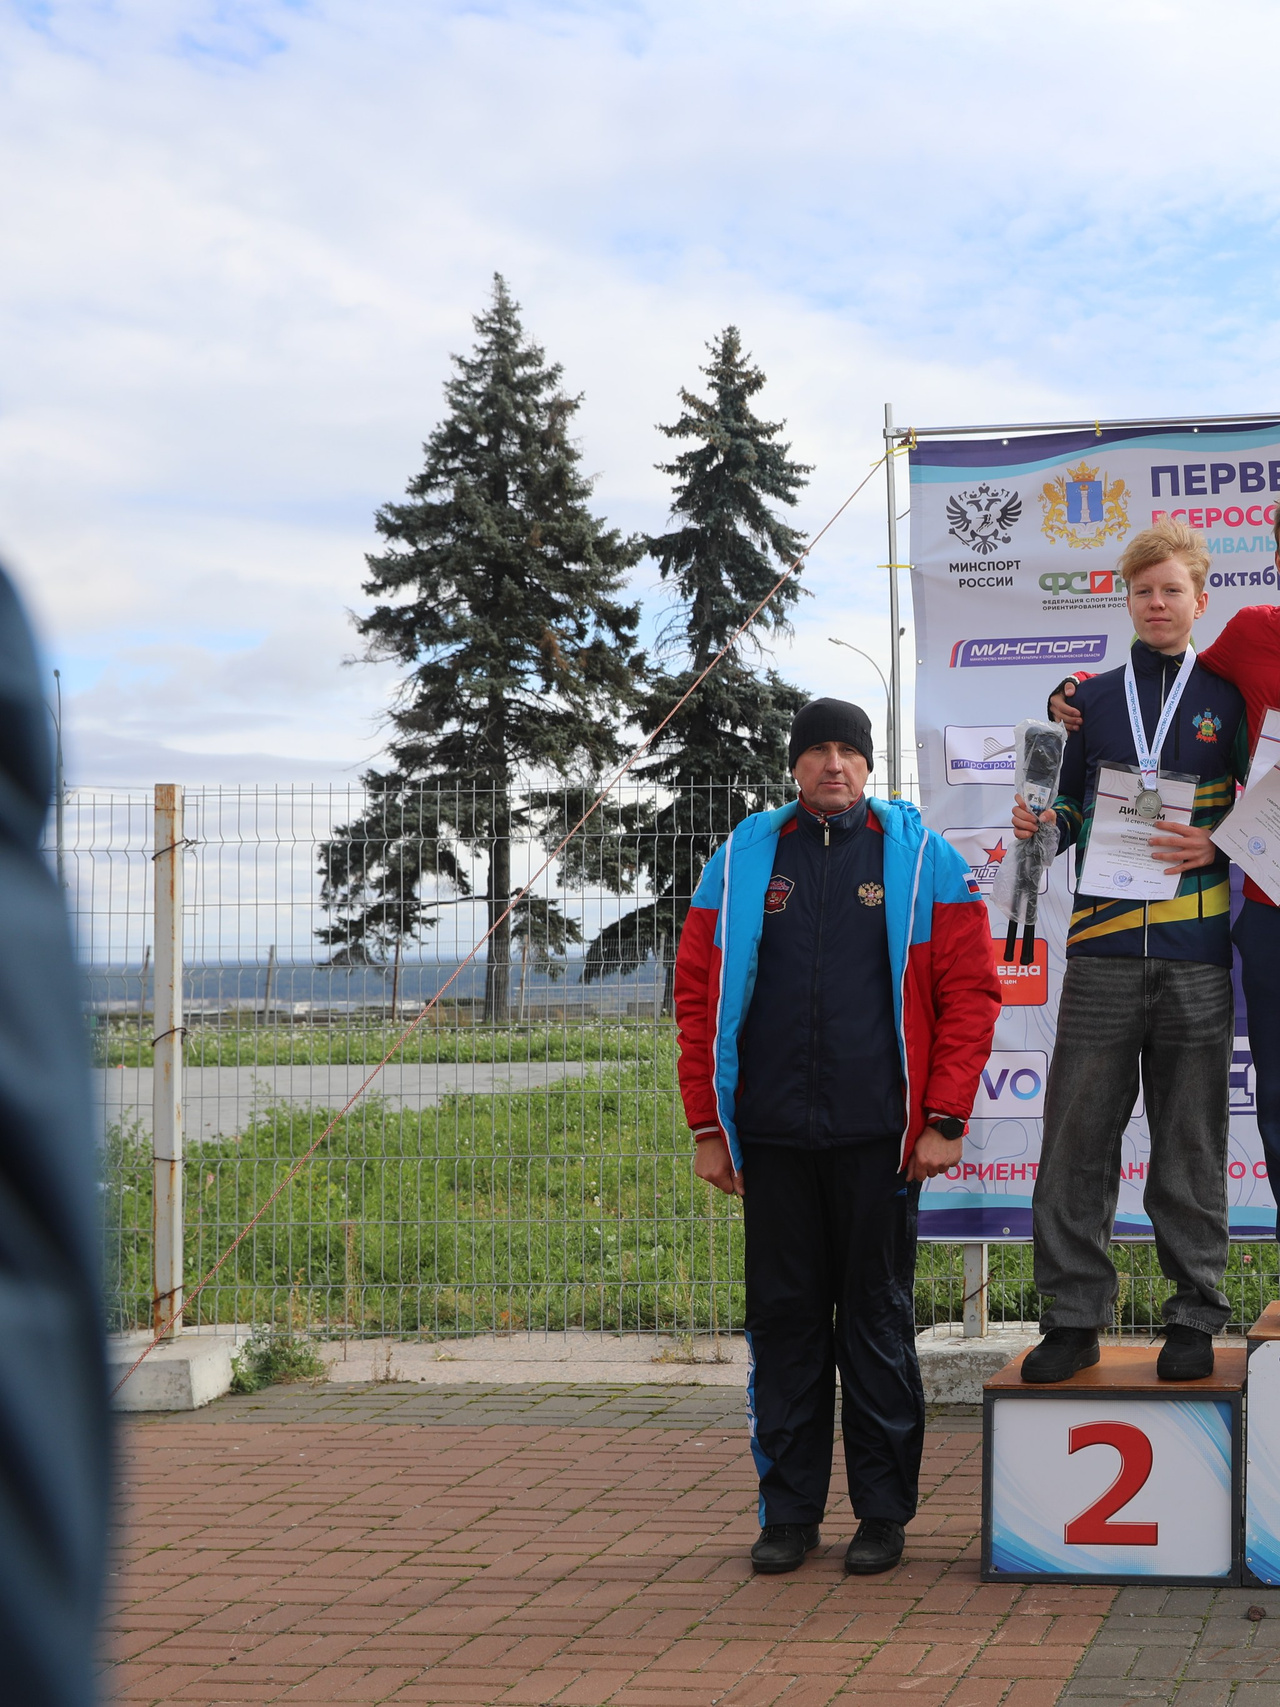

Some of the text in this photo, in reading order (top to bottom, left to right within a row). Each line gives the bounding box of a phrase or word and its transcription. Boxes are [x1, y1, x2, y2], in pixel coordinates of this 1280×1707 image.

[949, 560, 1021, 573] МИНСПОРТ
[959, 576, 1014, 588] РОССИИ
[1042, 603, 1106, 611] ОРИЕНТИРОВАНИЯ
[970, 640, 1101, 657] МИНСПОРТ
[1064, 1420, 1158, 1546] 2
